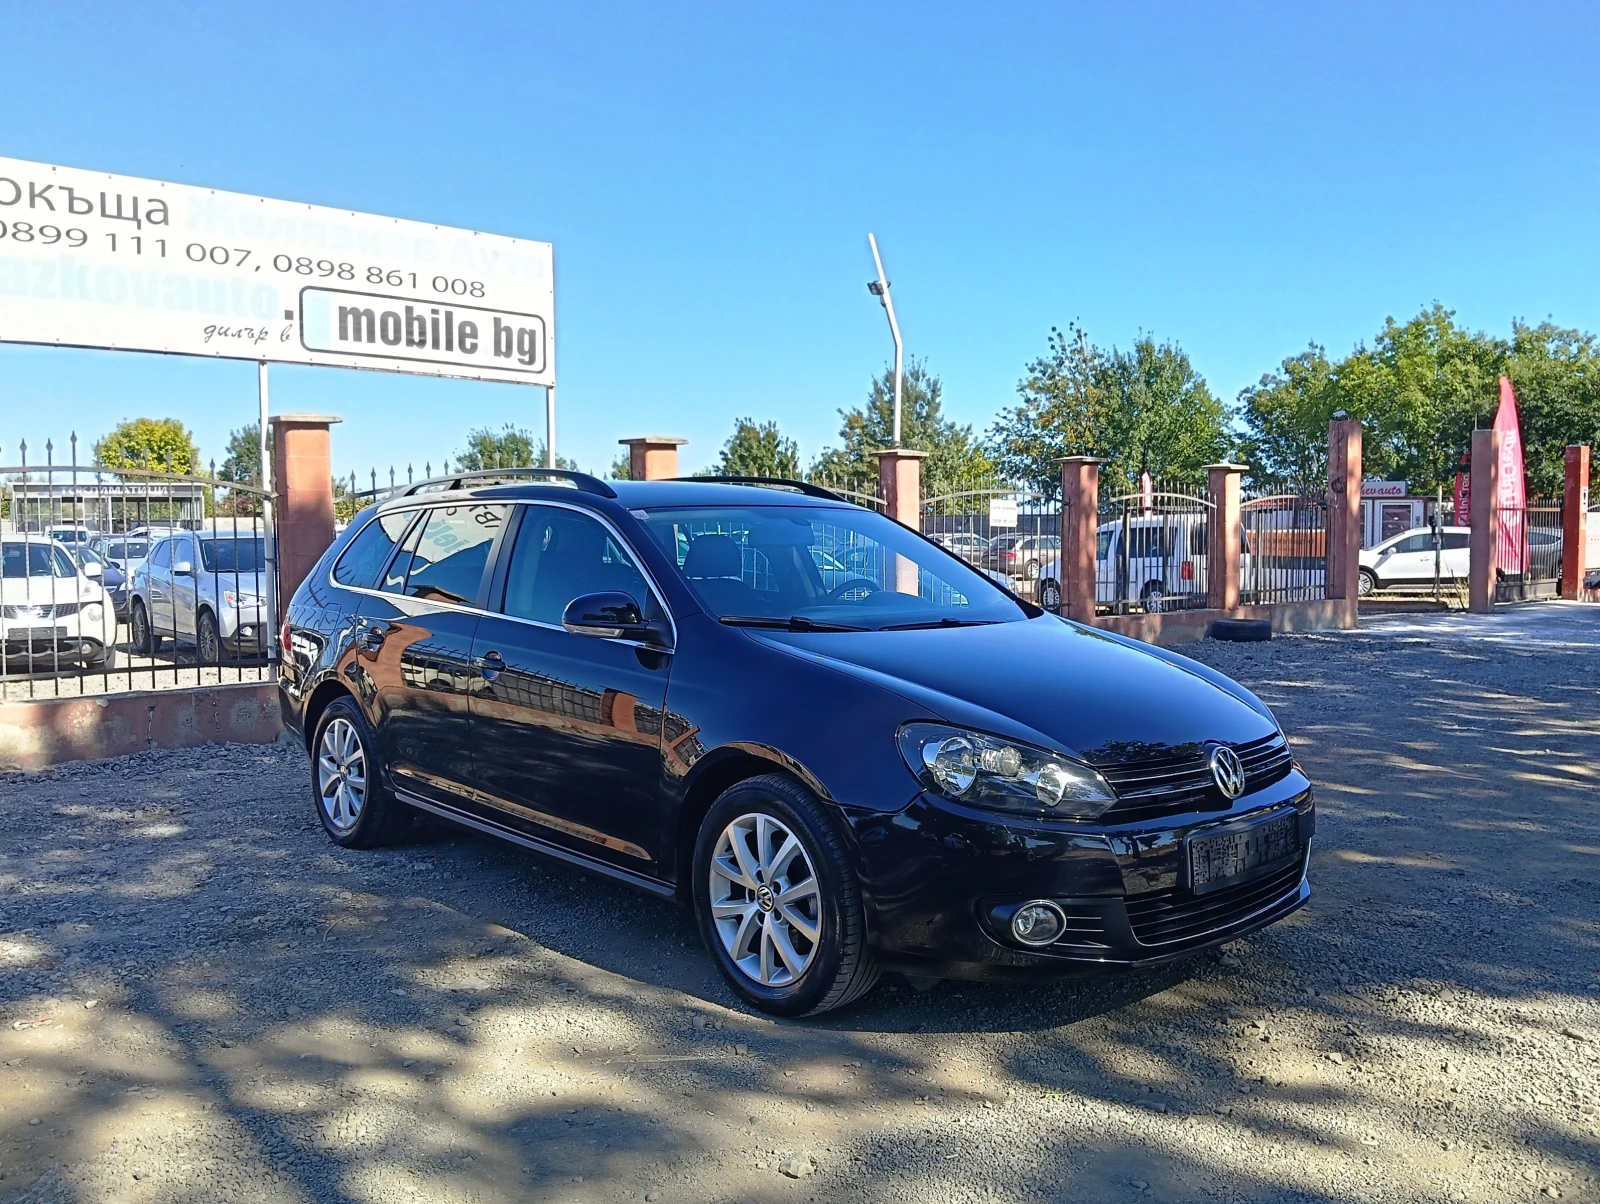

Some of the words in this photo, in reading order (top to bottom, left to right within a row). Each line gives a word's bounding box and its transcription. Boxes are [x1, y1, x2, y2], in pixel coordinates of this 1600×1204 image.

[105, 232, 167, 258] 111
[185, 242, 262, 273] 007,
[272, 254, 356, 281] 0898
[366, 266, 418, 289] 861
[432, 275, 486, 298] 008
[338, 304, 479, 355] mobile
[1378, 485, 1403, 495] auto
